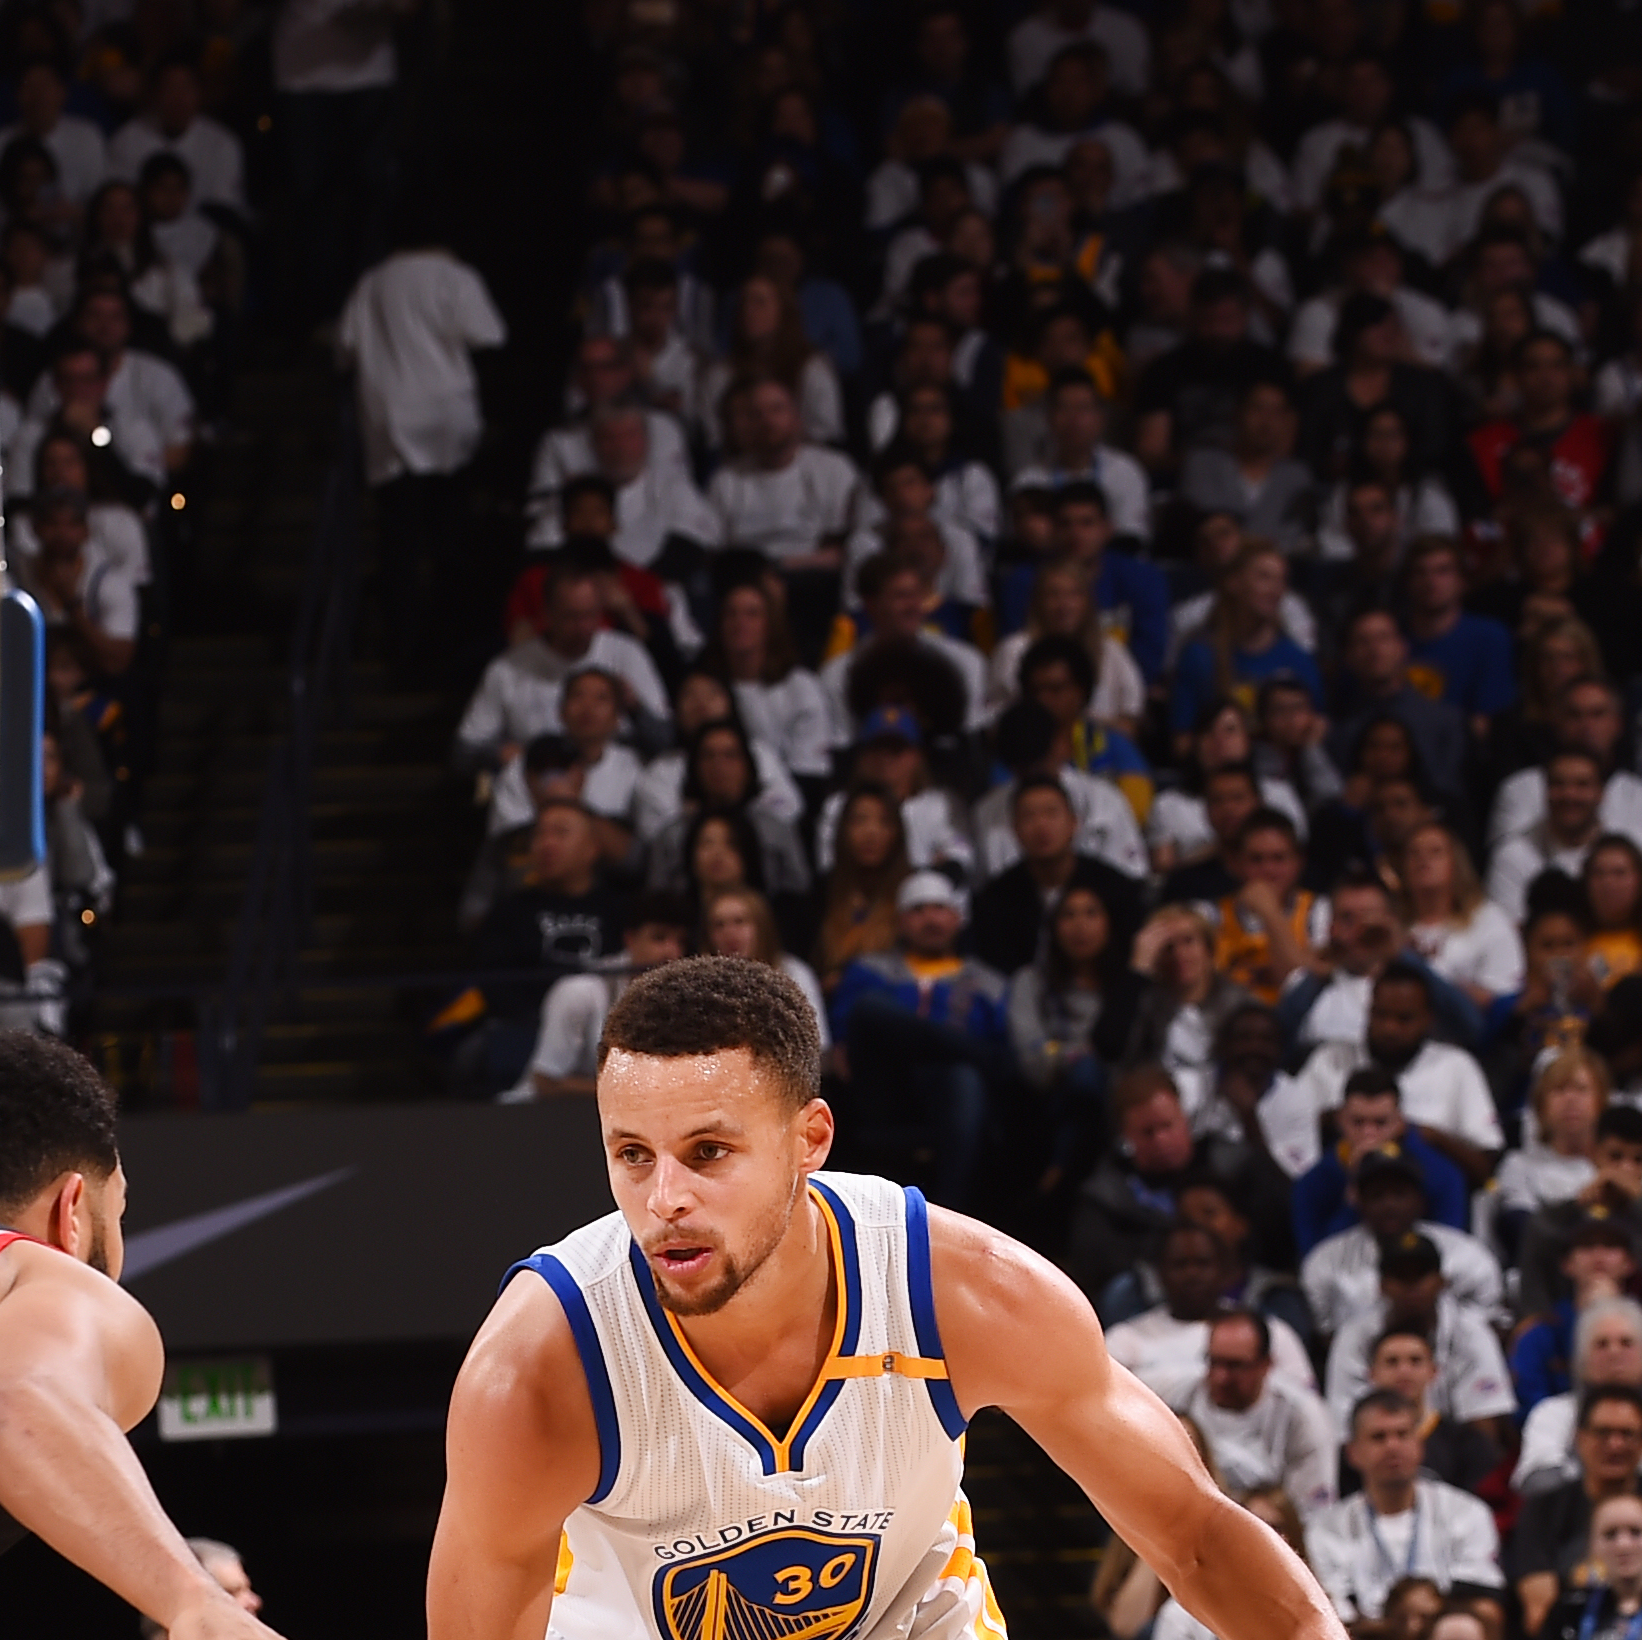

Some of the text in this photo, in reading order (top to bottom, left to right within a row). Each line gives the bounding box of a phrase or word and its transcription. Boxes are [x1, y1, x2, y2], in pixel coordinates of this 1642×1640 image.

[179, 1364, 254, 1424] EXIT
[655, 1509, 895, 1560] GOLDEN STATE
[772, 1552, 857, 1605] 30
